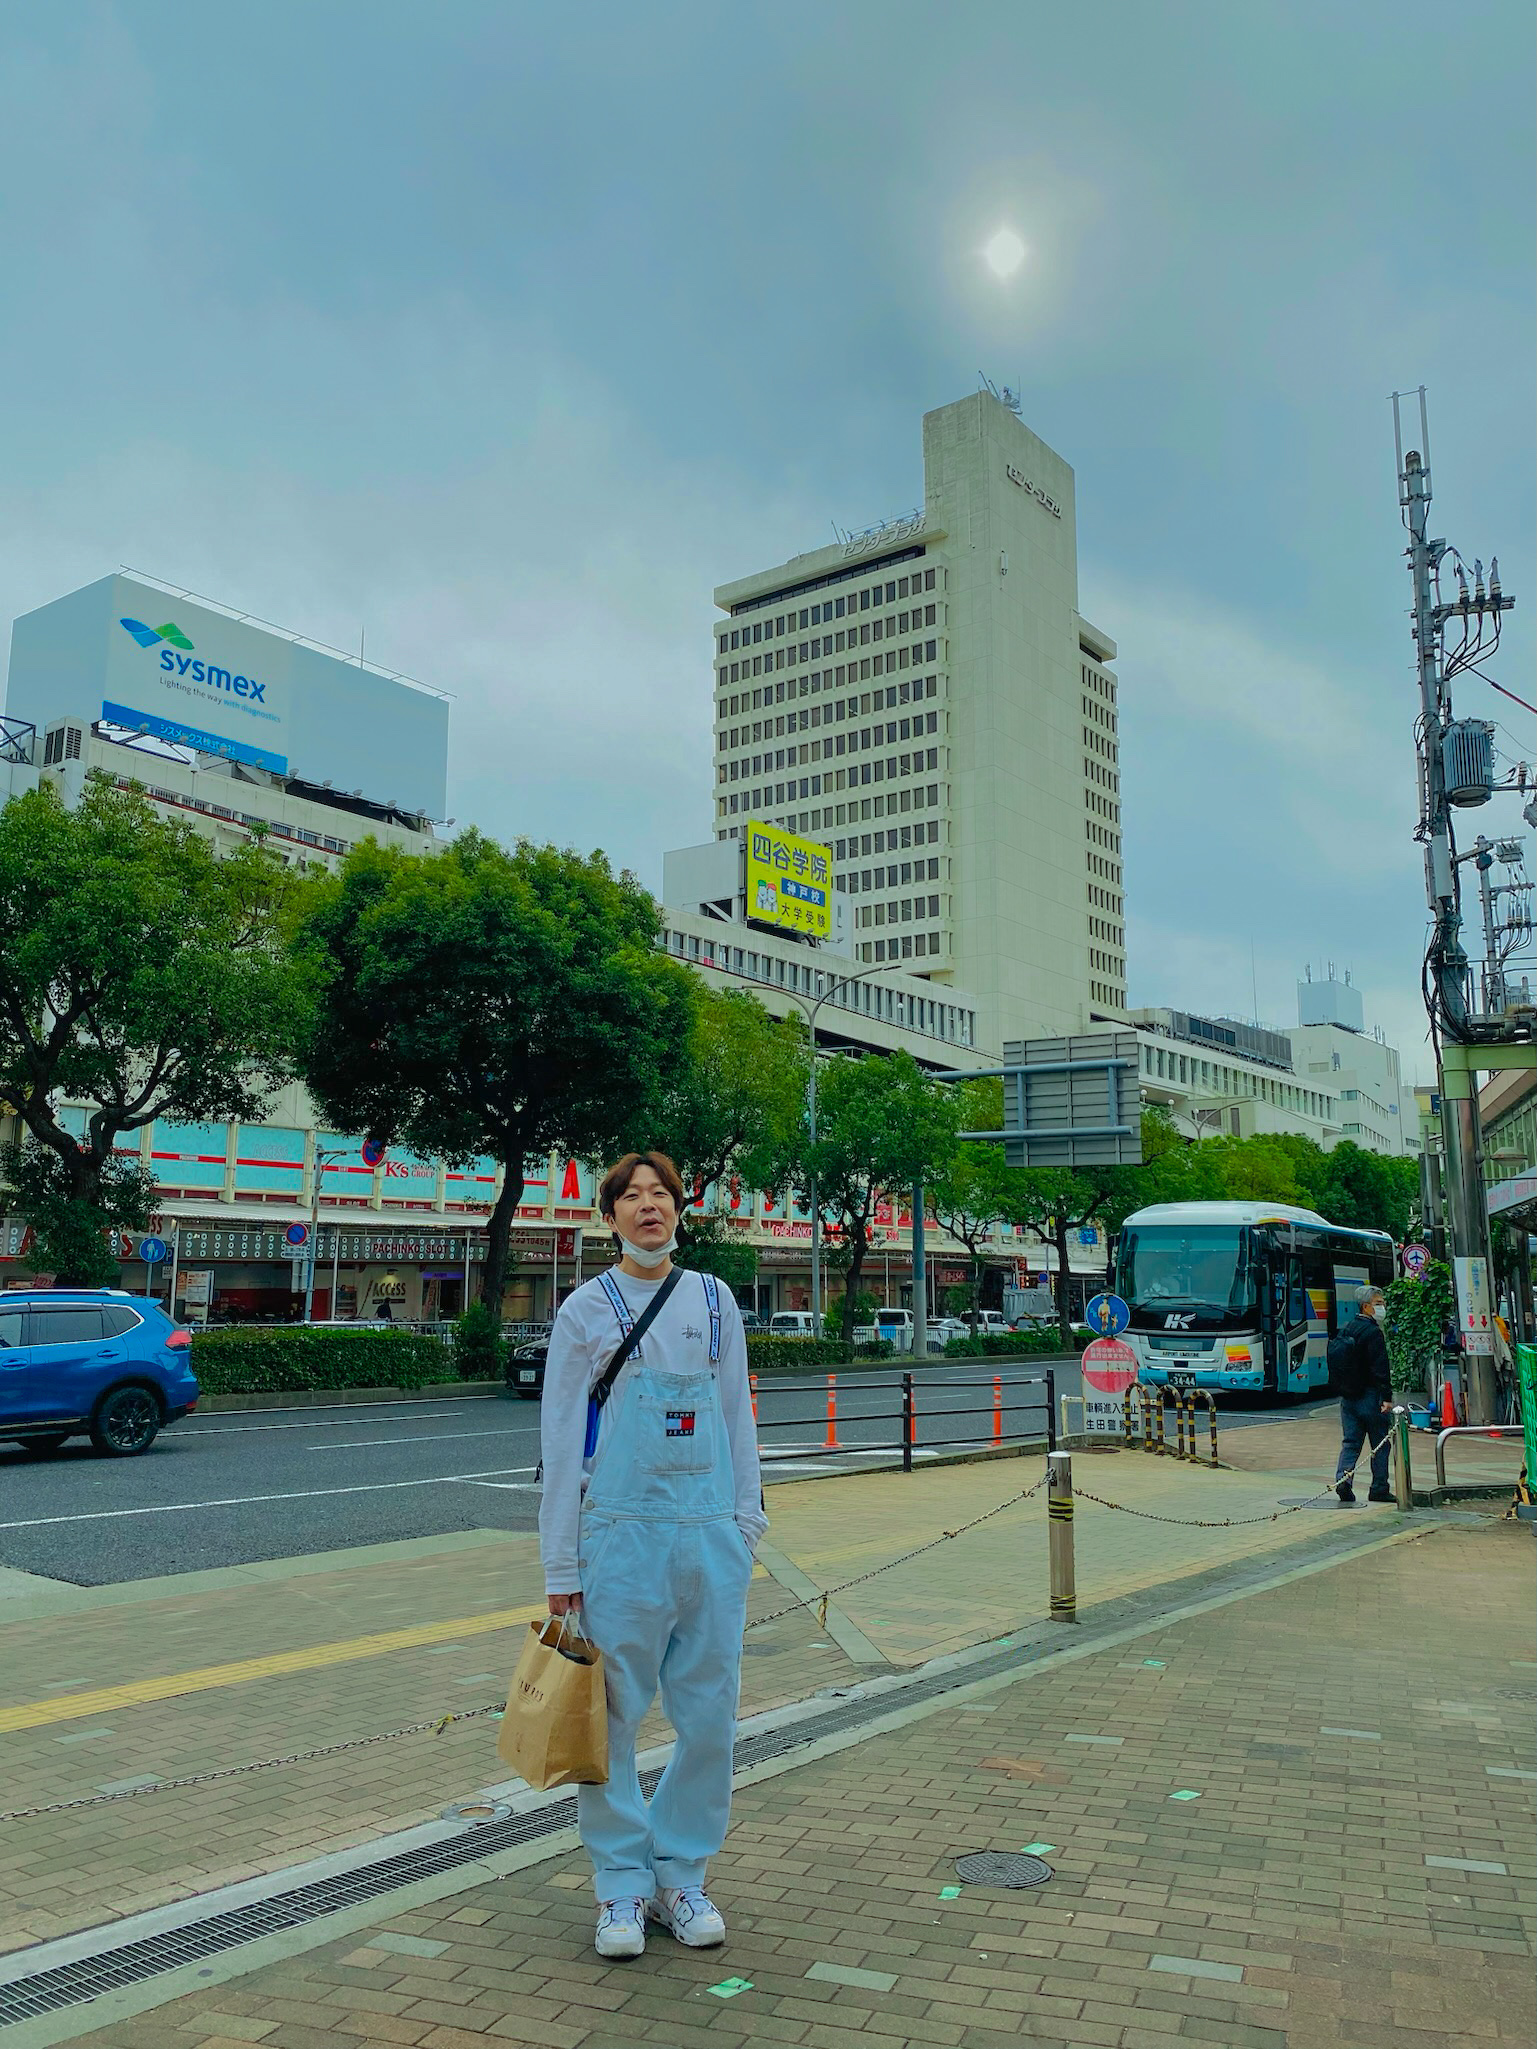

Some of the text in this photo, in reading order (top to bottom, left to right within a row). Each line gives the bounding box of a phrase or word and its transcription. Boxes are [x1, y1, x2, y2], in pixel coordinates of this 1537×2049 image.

[160, 650, 266, 704] sysmex
[159, 677, 281, 724] Lighting the way with diagnostics
[753, 832, 828, 885] 四谷学院
[786, 880, 821, 905] 神戸校
[781, 902, 826, 929] 大学受験
[411, 1169, 435, 1178] GROUP
[372, 1243, 448, 1254] PACHINKO SLOT
[372, 1282, 406, 1297] ACCESS
